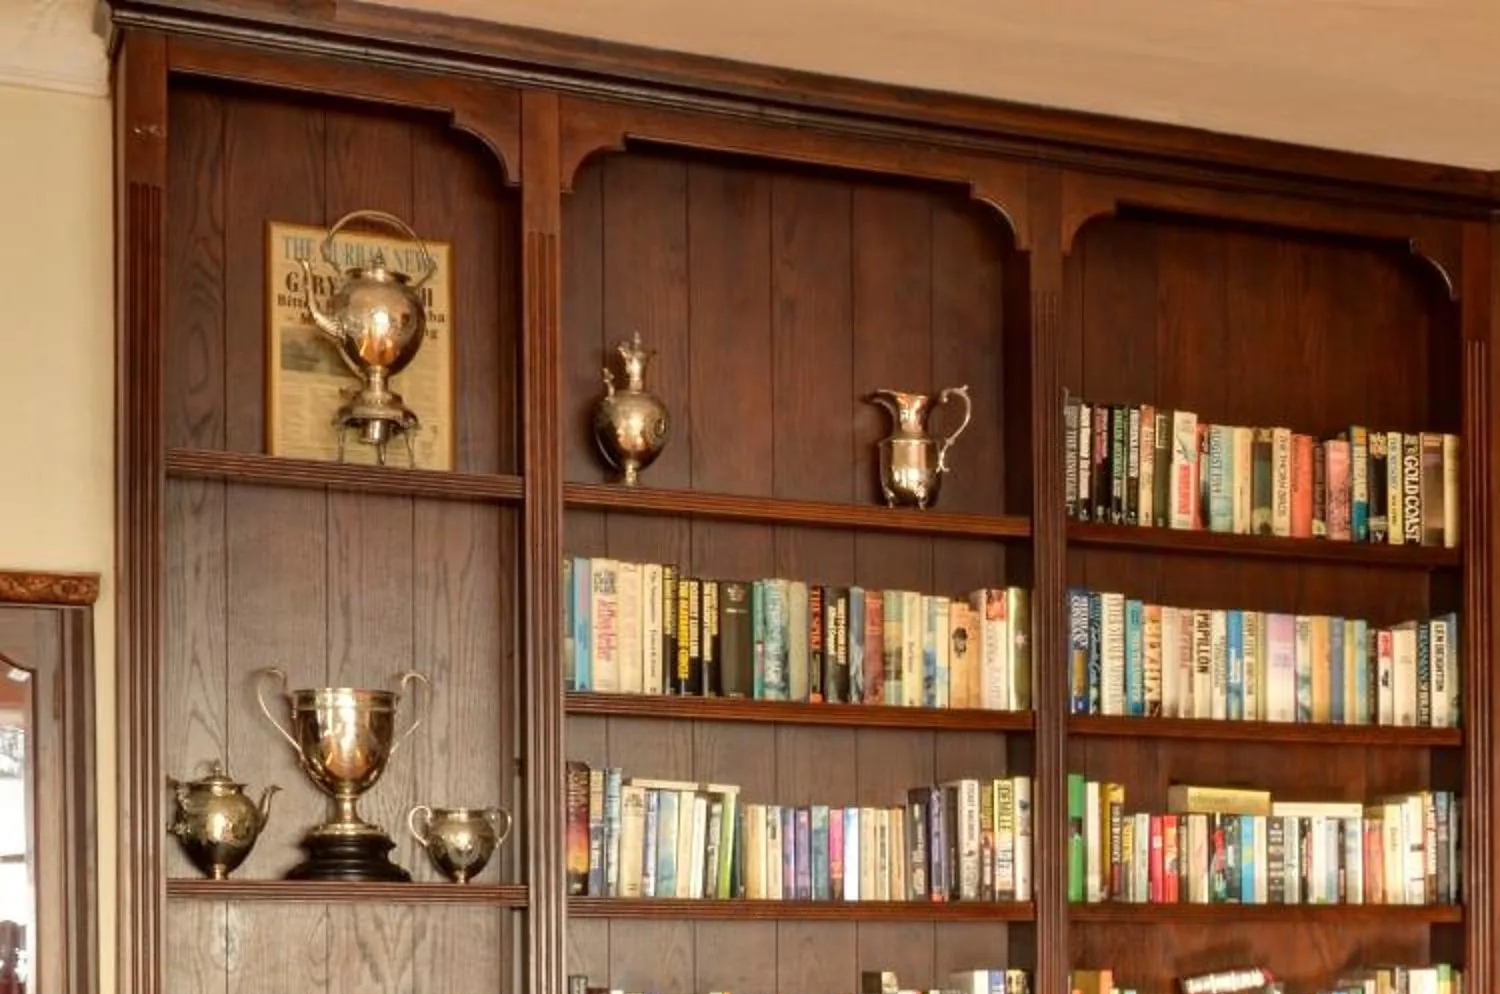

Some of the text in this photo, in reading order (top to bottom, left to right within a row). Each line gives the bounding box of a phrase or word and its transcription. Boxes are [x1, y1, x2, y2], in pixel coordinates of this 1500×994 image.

[1404, 456, 1420, 543] GOLD COAST
[1197, 613, 1211, 675] PAPILLON
